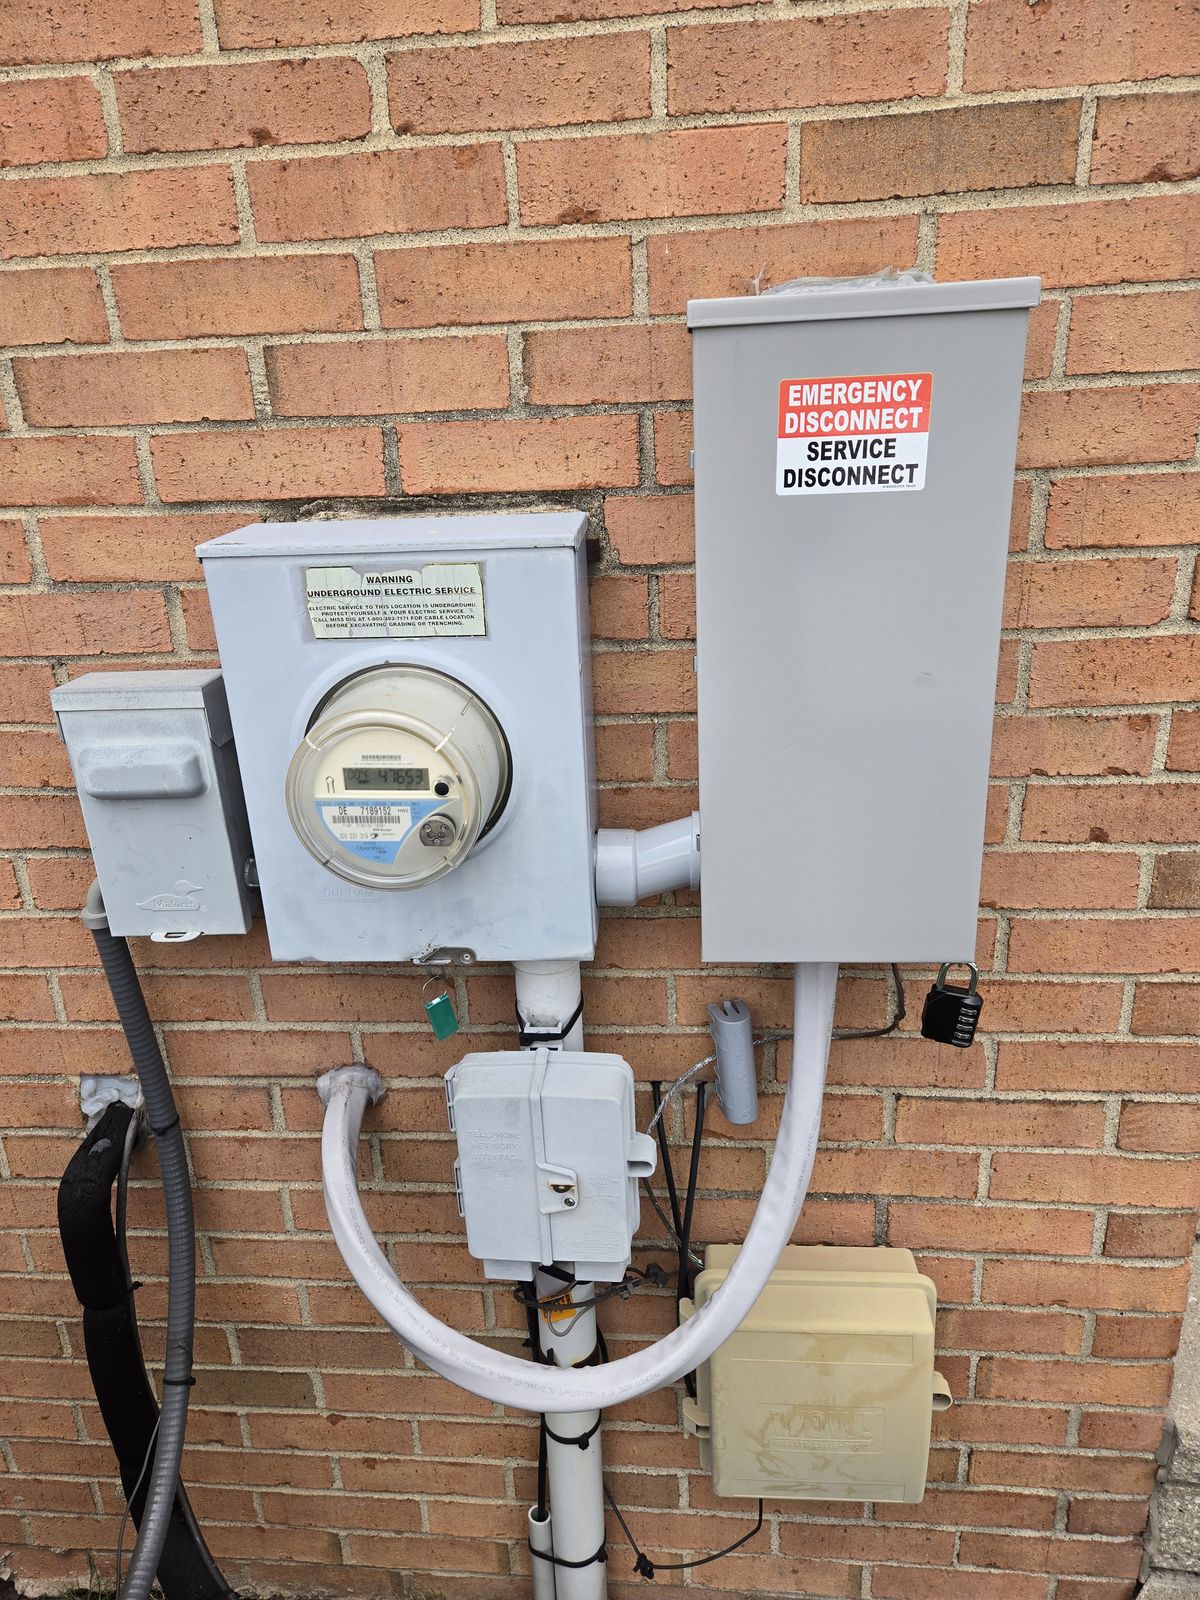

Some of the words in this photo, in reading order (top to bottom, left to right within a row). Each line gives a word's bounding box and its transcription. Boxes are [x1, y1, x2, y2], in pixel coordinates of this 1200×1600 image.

[789, 380, 922, 406] EMERGENCY
[785, 407, 922, 433] DISCONNECT
[807, 438, 896, 461] SERVICE
[784, 463, 918, 488] DISCONNECT
[366, 575, 413, 584] WARNING
[307, 589, 381, 598] UNDERGROUND
[384, 587, 432, 596] ELECTRIC
[435, 586, 476, 595] SERVICE
[378, 768, 423, 785] 47653
[338, 806, 348, 815] DE
[360, 806, 392, 815] 7189152
